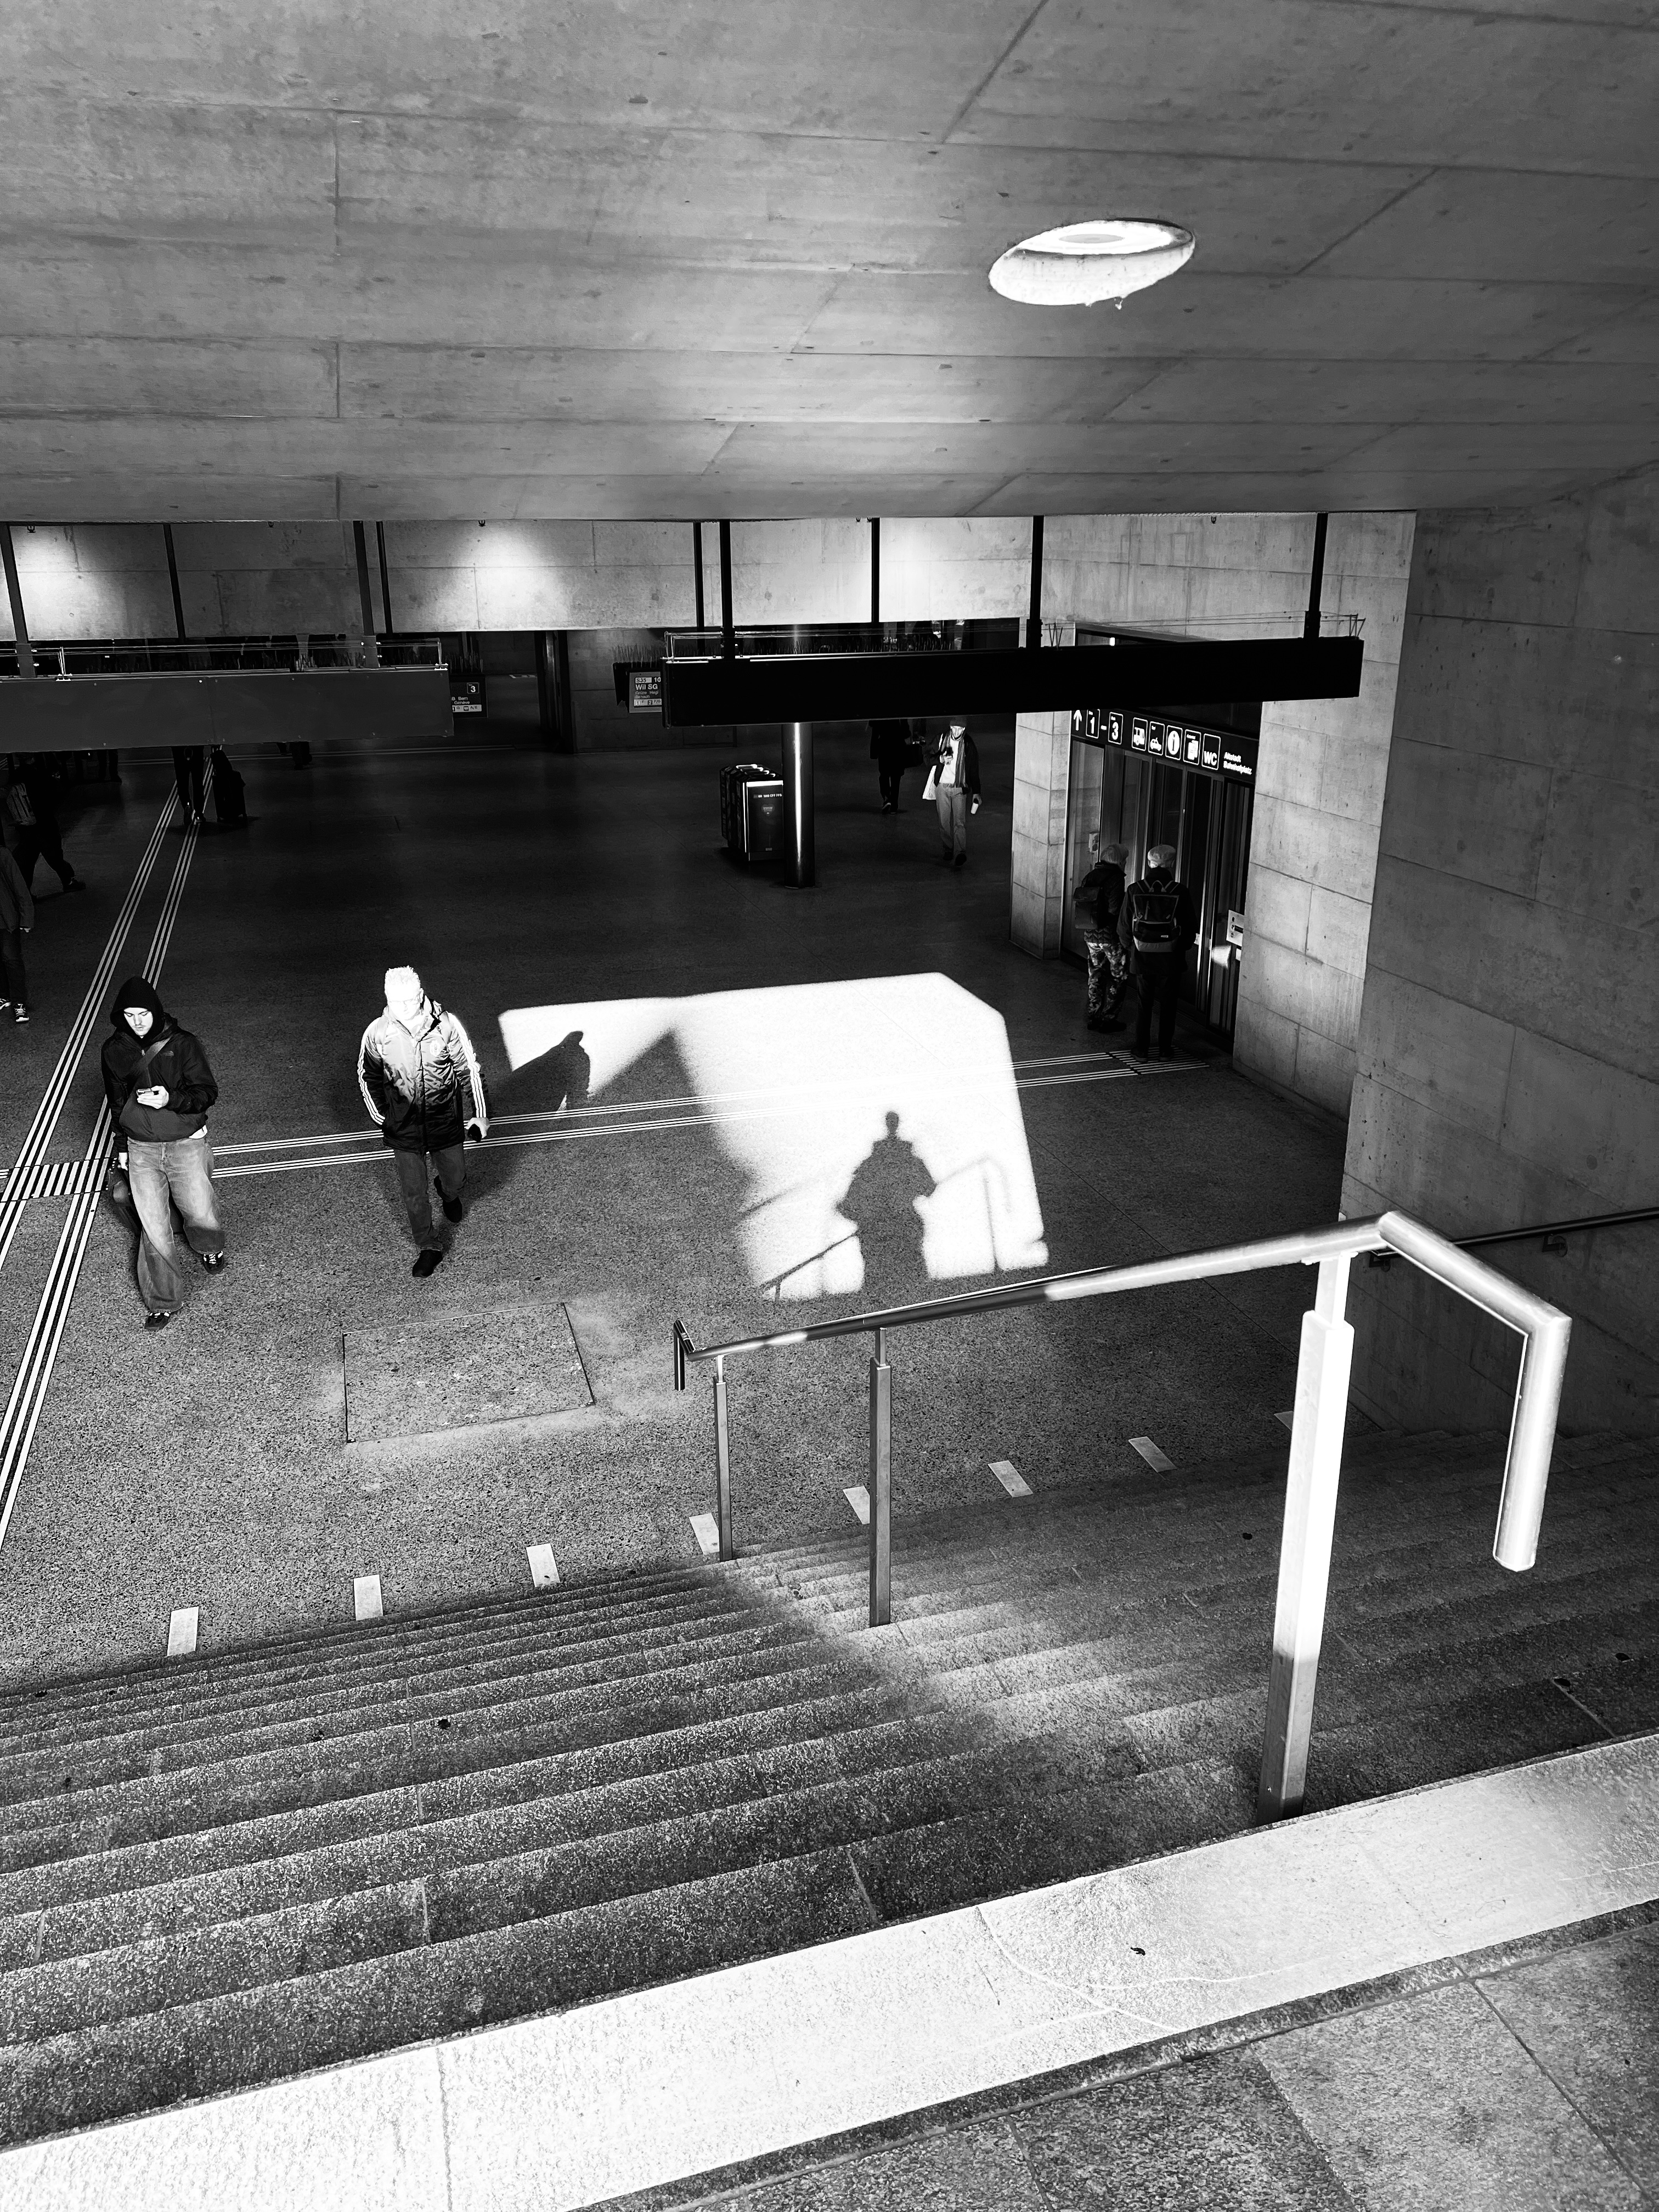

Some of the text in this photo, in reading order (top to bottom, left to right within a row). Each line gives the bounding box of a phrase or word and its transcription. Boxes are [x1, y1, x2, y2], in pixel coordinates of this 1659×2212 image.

[1090, 716, 1095, 734] 1
[1111, 721, 1119, 740] 3
[1204, 751, 1217, 766] WC
